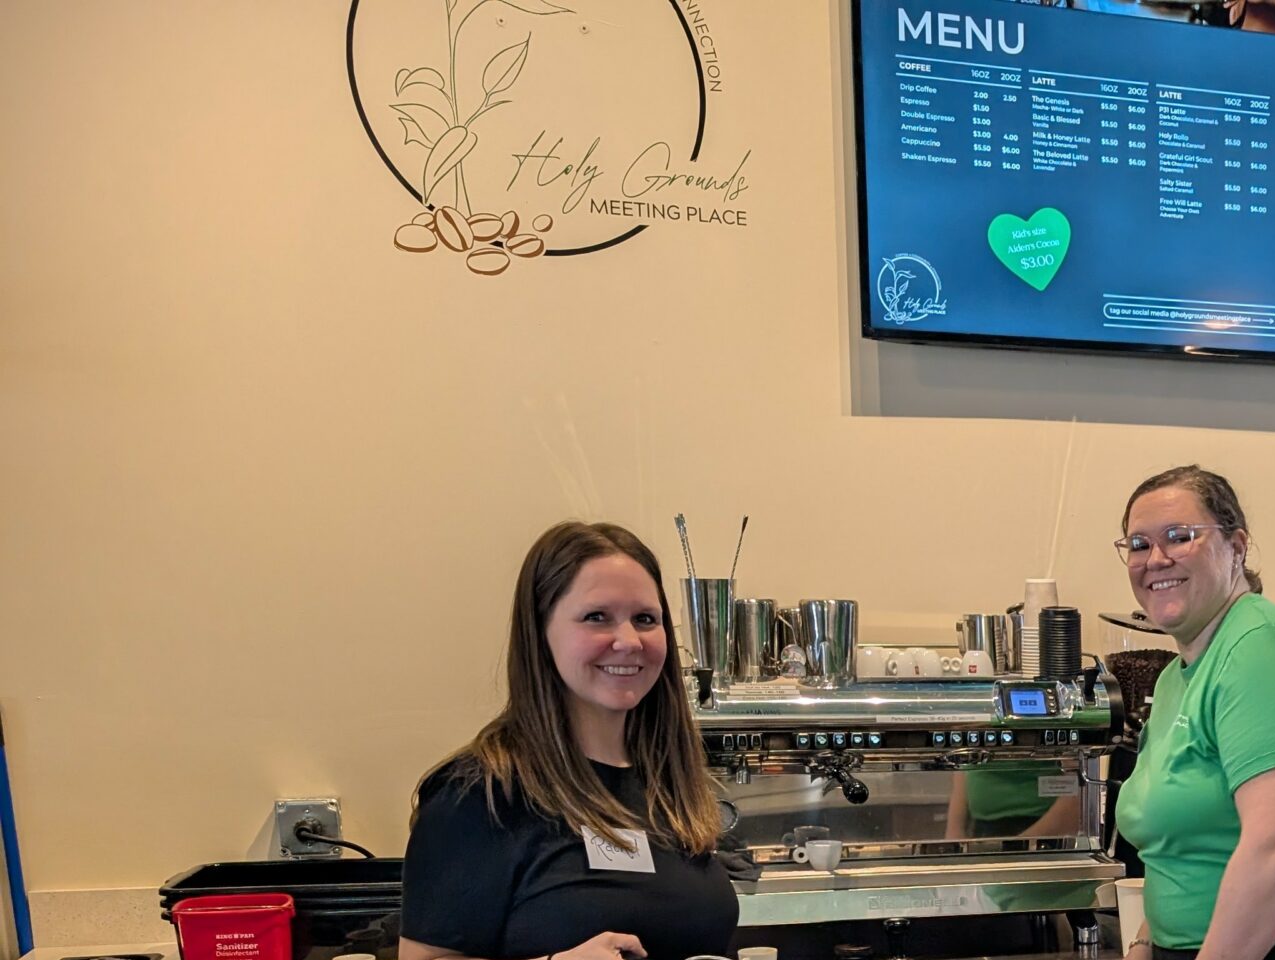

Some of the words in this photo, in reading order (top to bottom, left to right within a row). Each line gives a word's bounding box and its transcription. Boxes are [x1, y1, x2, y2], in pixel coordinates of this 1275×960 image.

[898, 8, 1024, 54] MENU
[899, 61, 931, 72] COFFEE
[1032, 76, 1055, 86] LATTE
[900, 83, 914, 92] Drip
[916, 84, 937, 94] Coffee
[974, 91, 988, 99] 2.00
[1003, 94, 1017, 102] 2.50
[1159, 91, 1182, 100] LATTE
[900, 97, 930, 107] Espresso
[973, 104, 989, 112] $1.50
[1046, 97, 1069, 105] Genesis
[1101, 103, 1117, 111] $5.50
[1128, 105, 1145, 114] $6.00
[901, 111, 924, 119] Double
[926, 112, 955, 122] Espresso
[973, 117, 991, 126] $3.00
[1032, 114, 1049, 122] Basic
[1057, 117, 1080, 125] Blessed
[1101, 120, 1118, 129] $5.50
[1128, 123, 1145, 132] $6.00
[901, 124, 937, 134] Americano
[973, 130, 991, 138] $3.00
[1003, 133, 1018, 141] 4.00
[1033, 131, 1046, 139] Milk
[1053, 134, 1071, 143] Honey
[1072, 136, 1091, 144] Latte
[1101, 138, 1118, 146] $5.50
[1128, 141, 1146, 149] $6.00
[1159, 132, 1172, 141] Holy
[1225, 138, 1241, 147] $5.50
[1250, 141, 1267, 149] $6.00
[901, 137, 940, 148] Cappuccino
[973, 144, 991, 152] $5.50
[1002, 146, 1020, 155] $6.00
[901, 153, 926, 161] Shaken
[928, 155, 956, 164] Espresso
[974, 159, 991, 168] $5.50
[1002, 162, 1020, 170] $6.00
[1033, 149, 1045, 158] The
[1047, 150, 1070, 160] Beloved
[1072, 153, 1089, 161] Latte
[1101, 155, 1118, 164] $5.50
[1128, 159, 1146, 167] $6.00
[1159, 152, 1182, 162] Grateful
[1196, 156, 1213, 164] Scout
[1224, 160, 1240, 168] $5.50
[1250, 163, 1267, 171] $6.00
[507, 130, 603, 214] Holy
[622, 142, 751, 202] Grounds
[1160, 179, 1174, 187] Salty
[1176, 180, 1192, 188] Sister
[1225, 184, 1240, 192] $5.50
[1250, 187, 1267, 195] $6.00
[591, 198, 680, 220] MEETING
[687, 207, 747, 226] PLACE
[1160, 198, 1171, 206] Free
[1224, 203, 1240, 211] $5.50
[1250, 206, 1267, 214] $6.00
[1012, 229, 1031, 240] Kid's
[1032, 227, 1046, 236] size
[1008, 242, 1035, 254] Aiden's
[1037, 238, 1060, 250] Cocoa
[1020, 254, 1054, 270] $3.00
[1110, 307, 1120, 316] tag
[1132, 309, 1149, 317] social
[1170, 310, 1251, 324] @holygroundsmeetingplace
